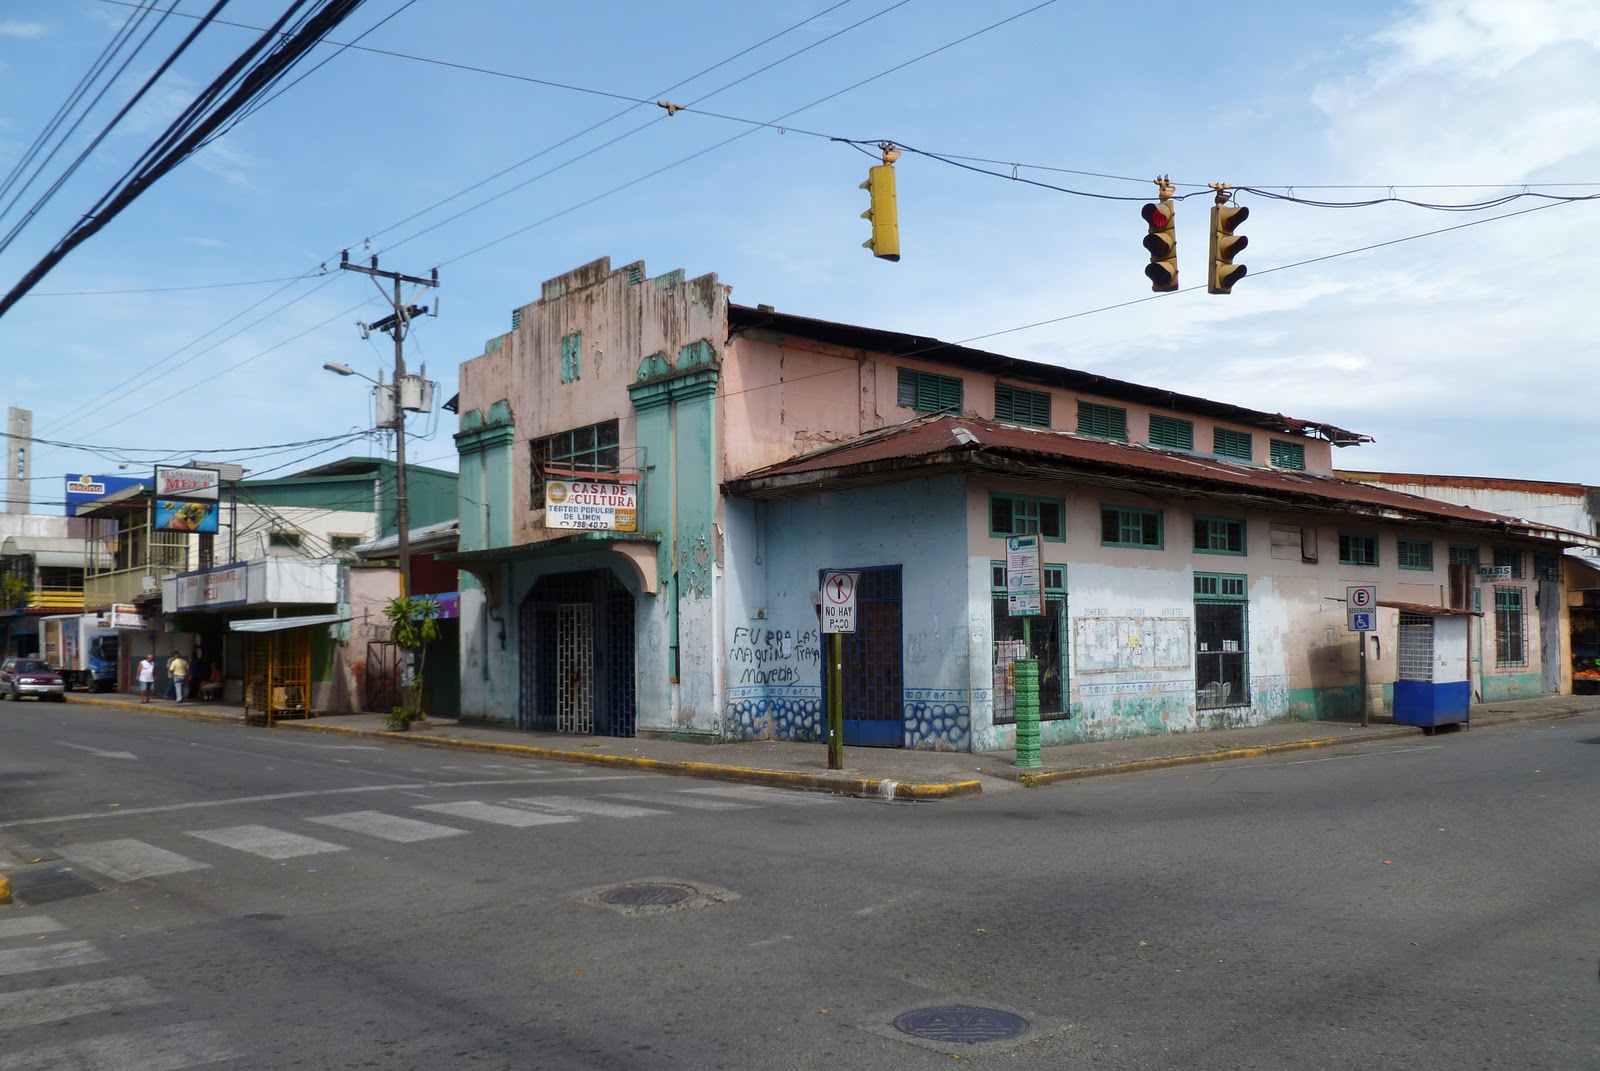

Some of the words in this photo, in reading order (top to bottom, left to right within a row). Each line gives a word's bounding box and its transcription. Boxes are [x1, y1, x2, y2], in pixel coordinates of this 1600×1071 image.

[69, 484, 103, 492] ekono
[572, 483, 607, 495] CASA
[612, 485, 628, 496] DE
[574, 494, 634, 507] CULTURA
[548, 505, 579, 513] TEATRO
[581, 506, 614, 515] POPULAR
[564, 513, 574, 521] DE
[1481, 566, 1510, 575] OASIS
[1357, 592, 1365, 603] E
[825, 606, 835, 616] NO
[838, 606, 853, 617] HAY
[1084, 608, 1109, 616] COMERCIO
[1162, 608, 1184, 616] DEPORTES
[797, 629, 818, 644] LAS
